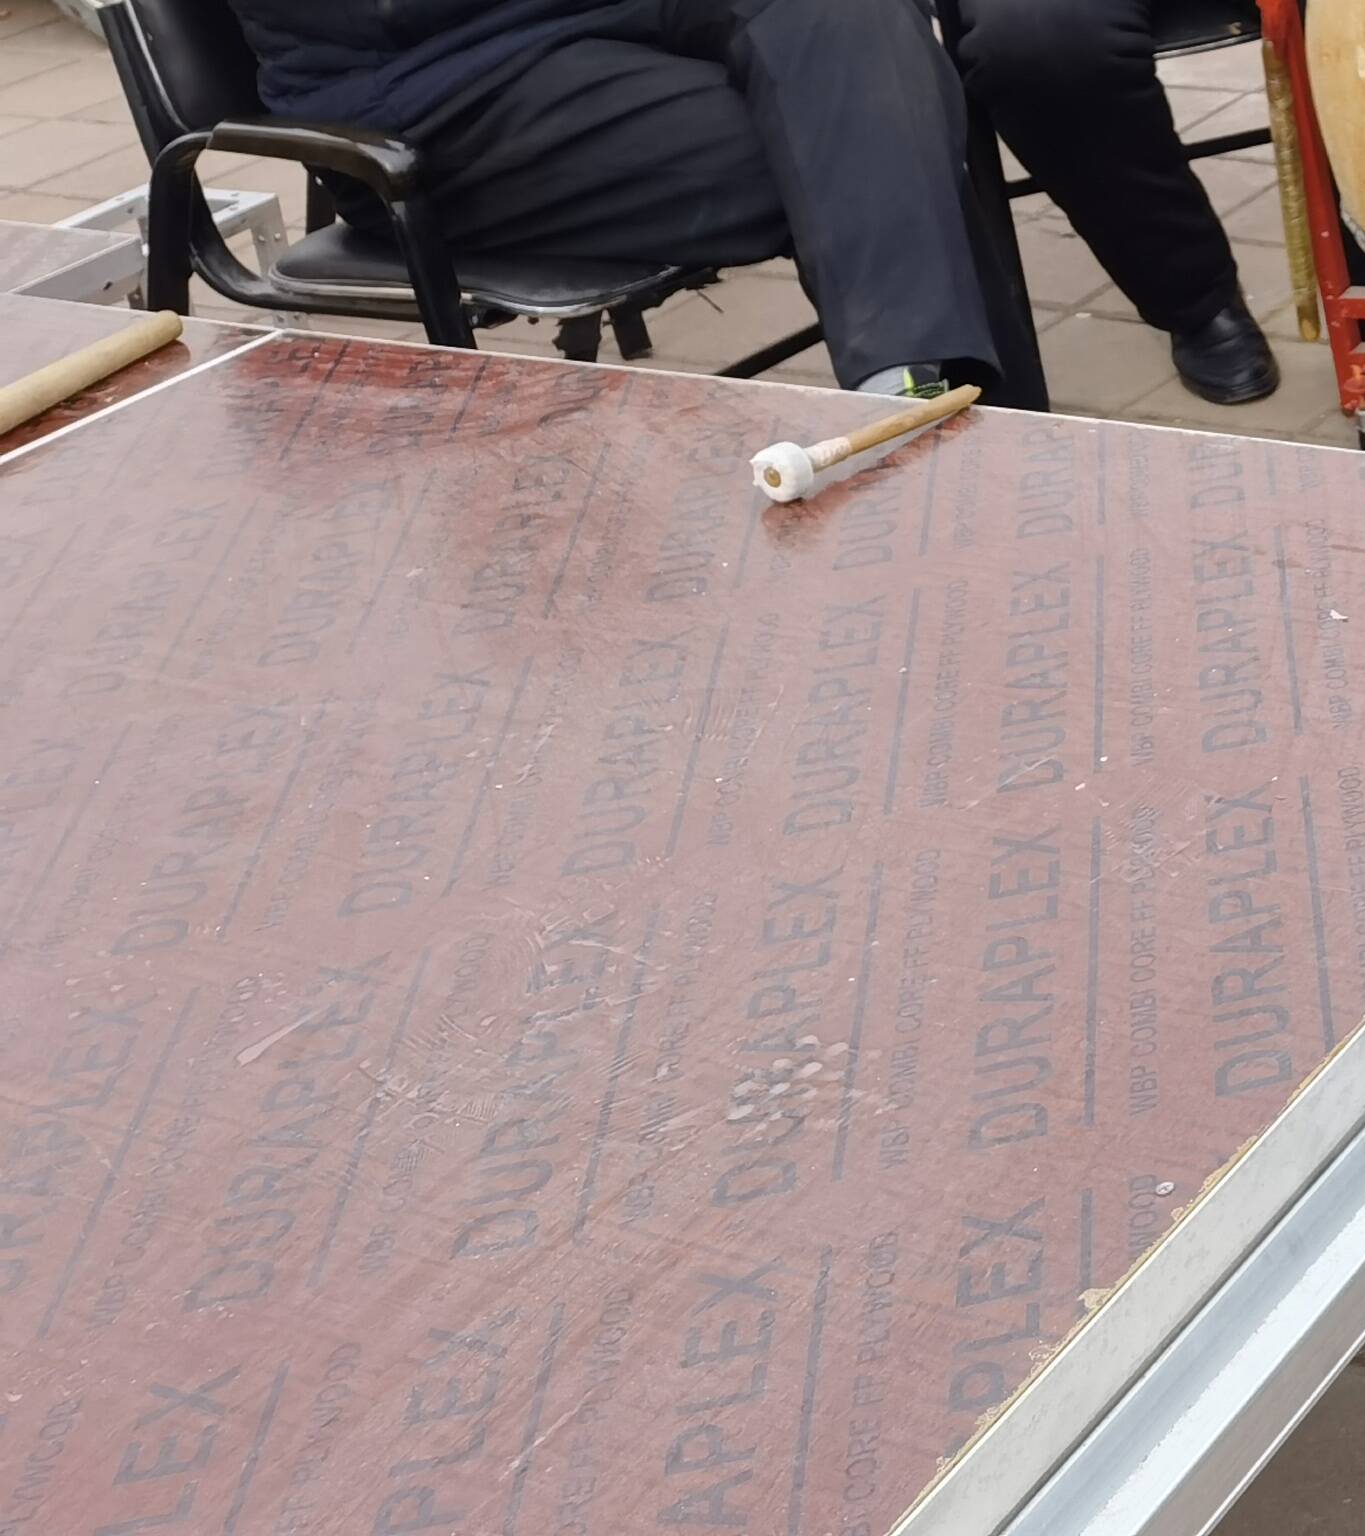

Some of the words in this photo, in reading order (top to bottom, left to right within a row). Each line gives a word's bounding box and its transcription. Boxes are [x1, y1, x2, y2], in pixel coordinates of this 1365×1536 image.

[997, 561, 1072, 794] DURAPLEX
[1192, 528, 1267, 754] DURAPLEX
[1129, 901, 1157, 922] FF
[1203, 776, 1293, 1097] DURAPLEX
[967, 822, 1063, 1150] DURAPLEX
[1129, 926, 1158, 984] CORE
[1129, 989, 1158, 1057] COMBI
[1129, 1064, 1159, 1115] WBP
[841, 1420, 878, 1502] CORE
